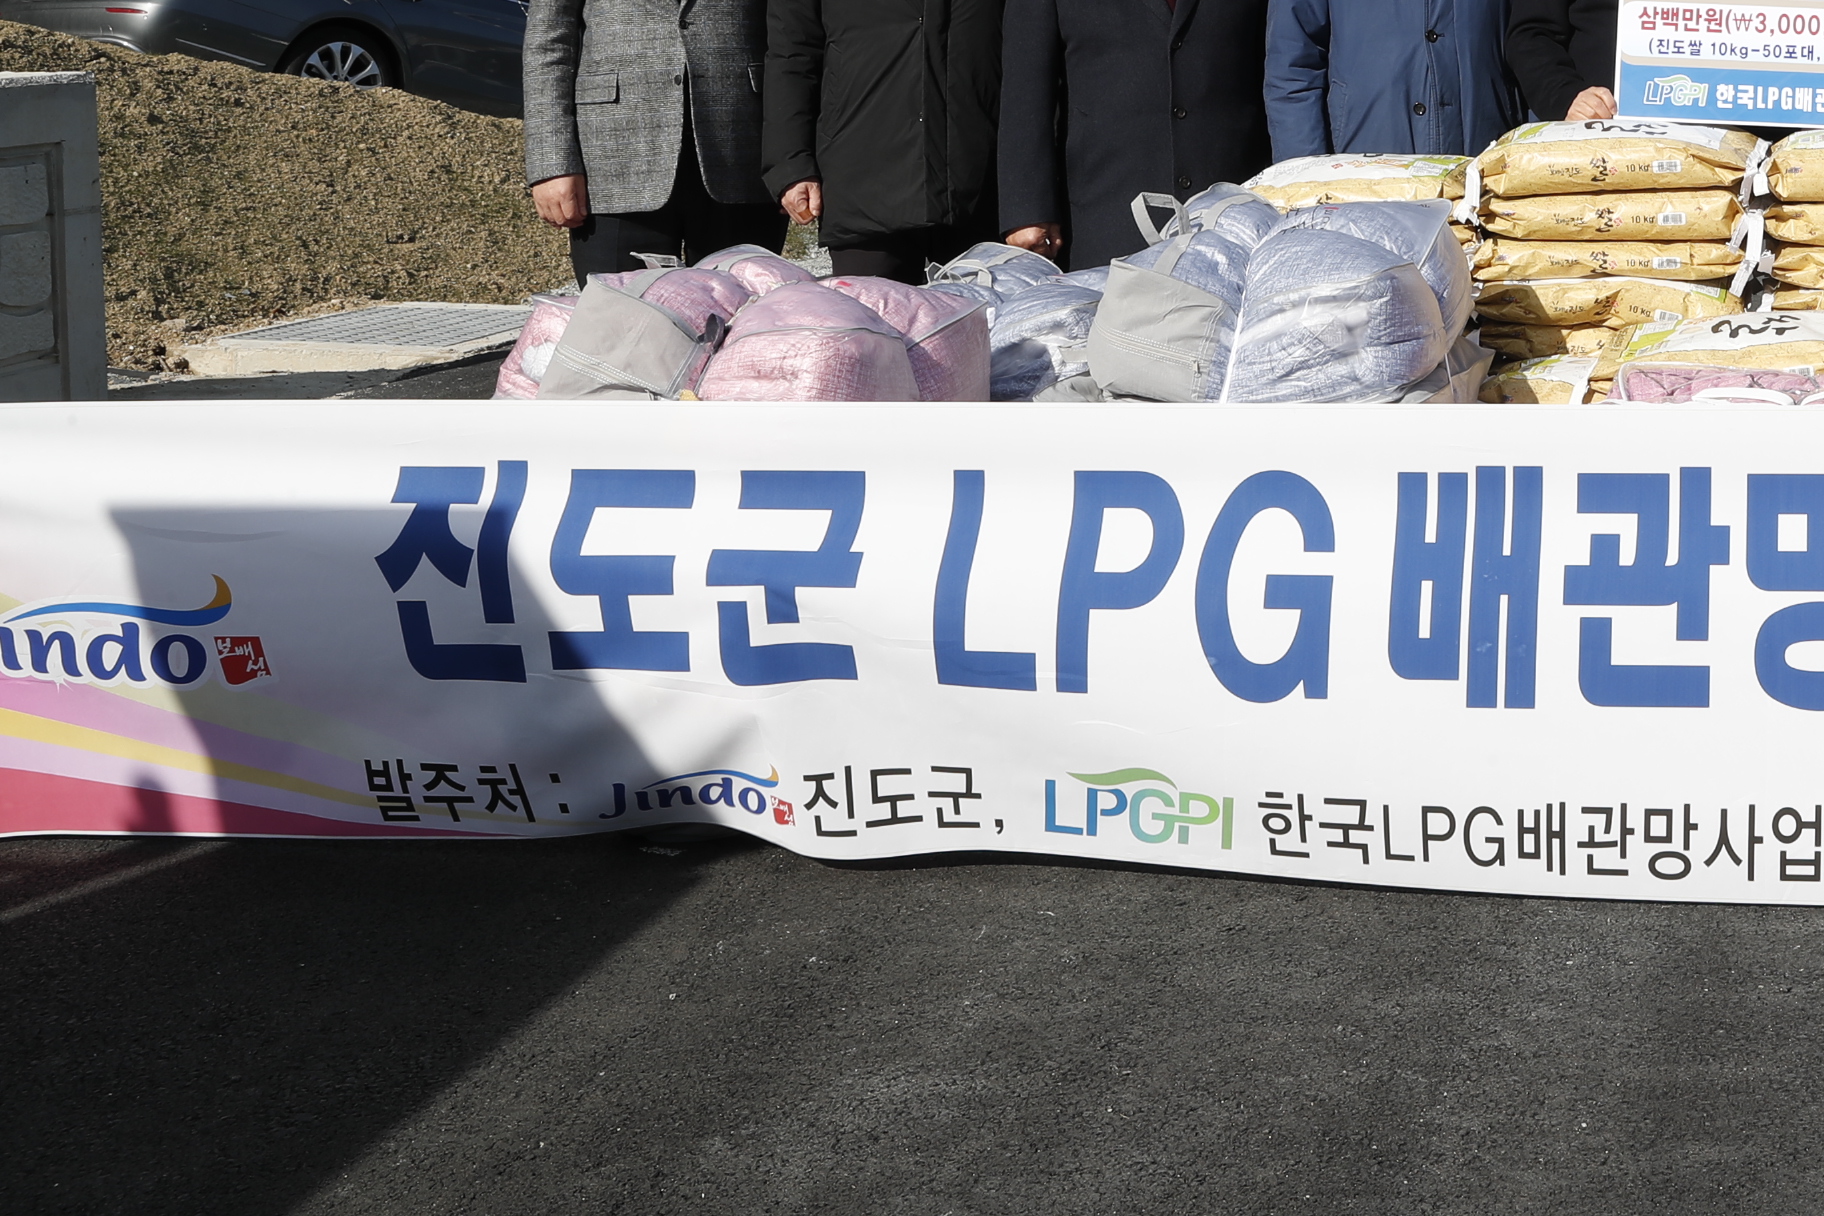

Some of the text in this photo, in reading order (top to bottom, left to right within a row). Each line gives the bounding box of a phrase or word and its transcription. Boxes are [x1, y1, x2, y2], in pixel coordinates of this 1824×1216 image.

[1649, 38, 1703, 57] (진도쌀
[1710, 41, 1821, 62] 10kg-50포대,
[1644, 78, 1710, 107] LPGPI
[374, 460, 865, 686] 진도군
[933, 470, 1336, 704] LPG
[364, 758, 536, 823] 발주처
[599, 776, 767, 820] Jindo
[803, 765, 1004, 837] 진도군,
[1045, 776, 1234, 851] LPGPI
